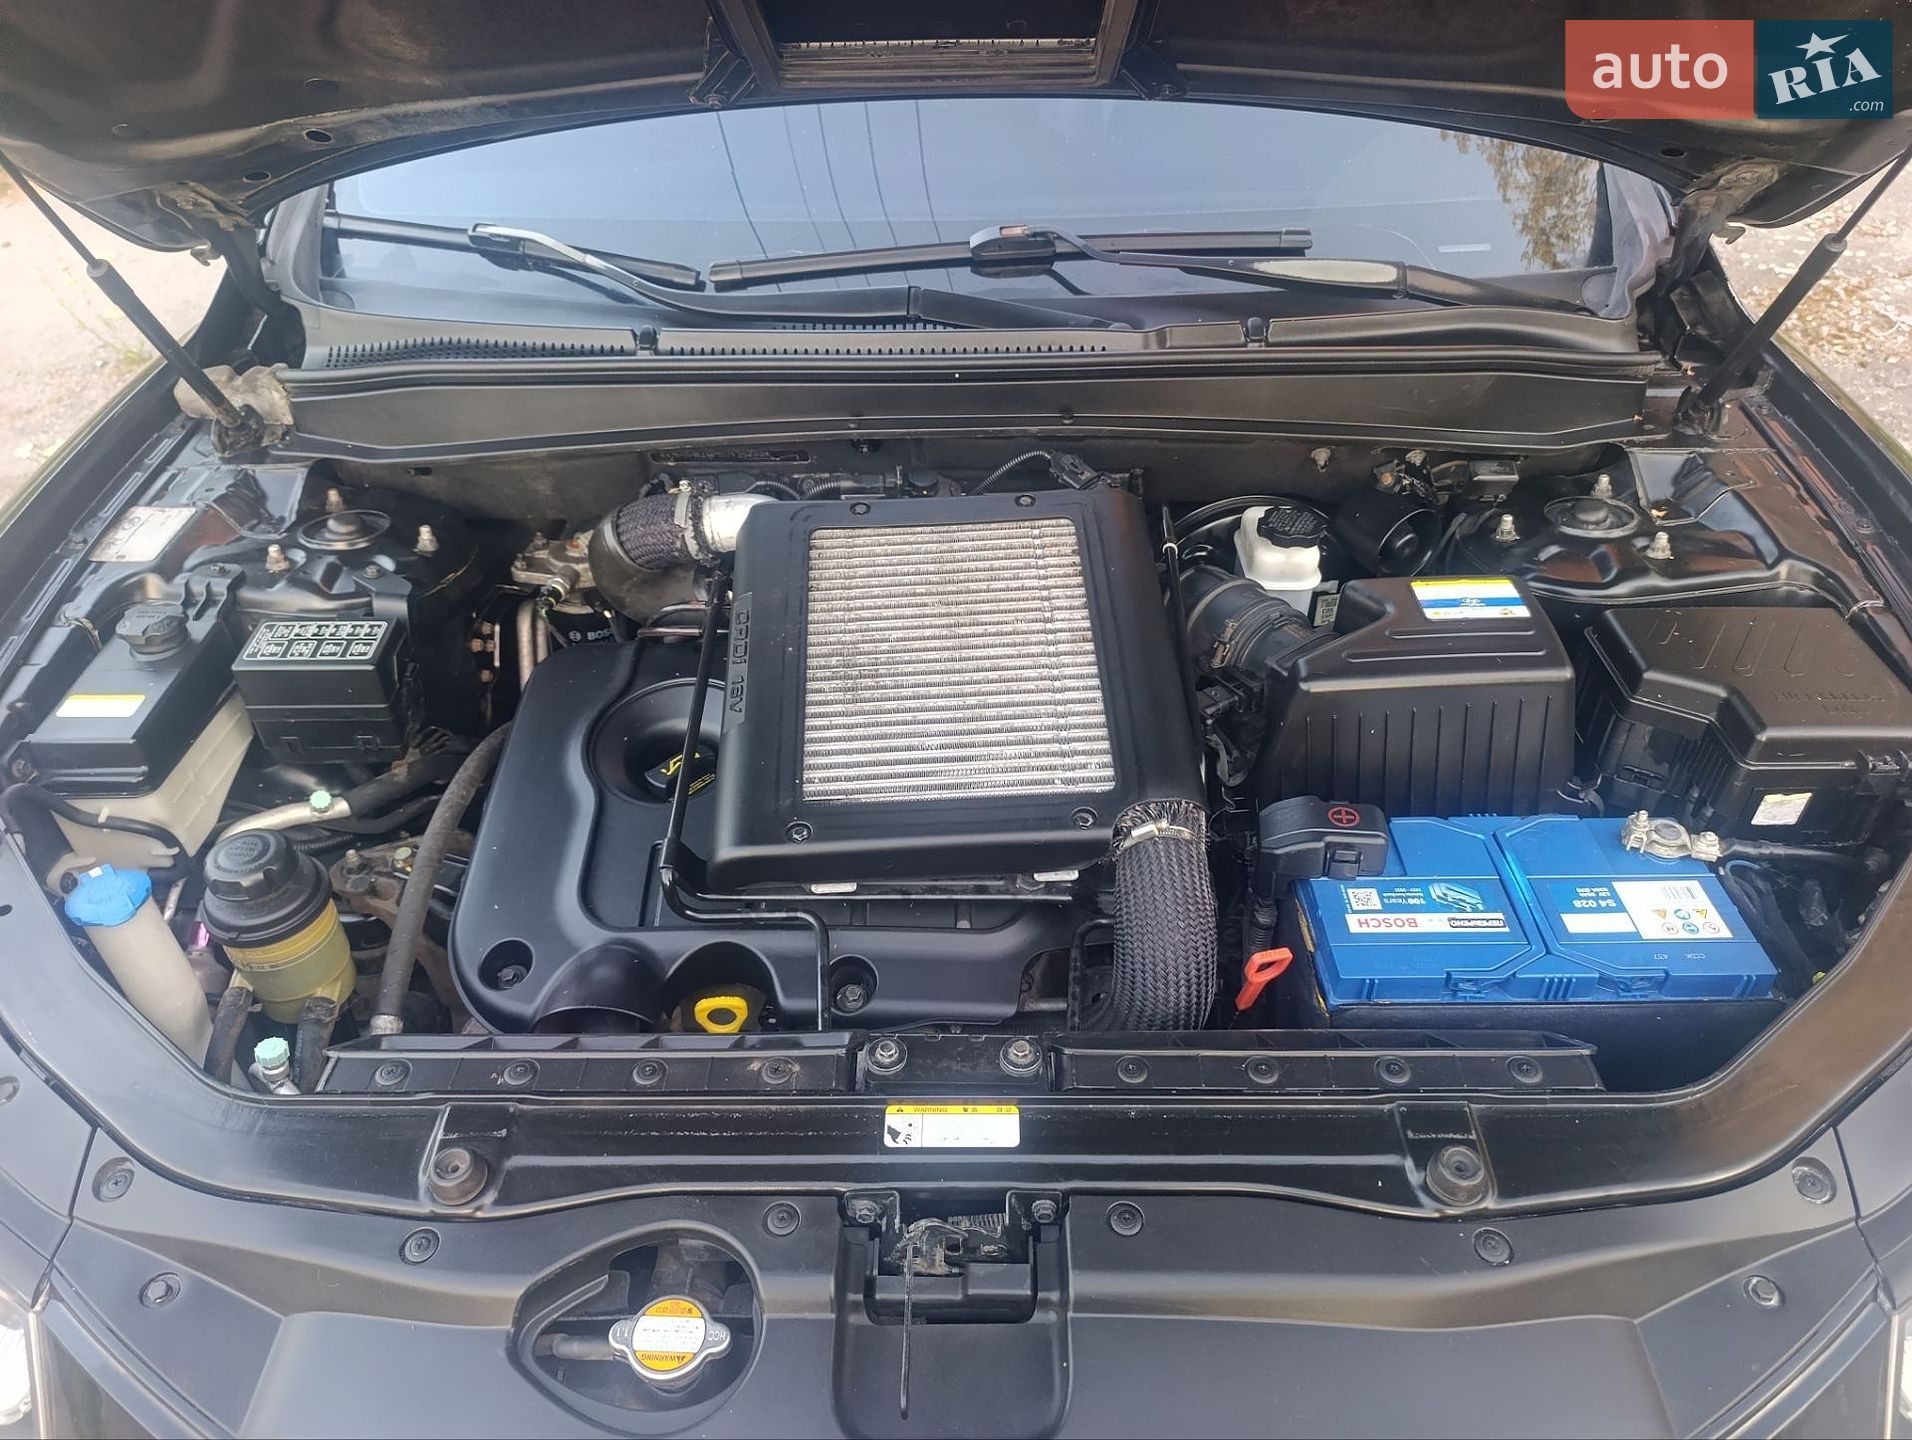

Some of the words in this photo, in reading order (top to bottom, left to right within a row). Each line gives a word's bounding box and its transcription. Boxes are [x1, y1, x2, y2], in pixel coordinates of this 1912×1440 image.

[729, 675, 745, 713] 16V
[1383, 897, 1407, 905] Years
[1407, 897, 1426, 905] 100
[1357, 917, 1419, 929] BOSCH
[708, 1330, 727, 1341] HCC
[640, 1353, 678, 1363] WARNING
